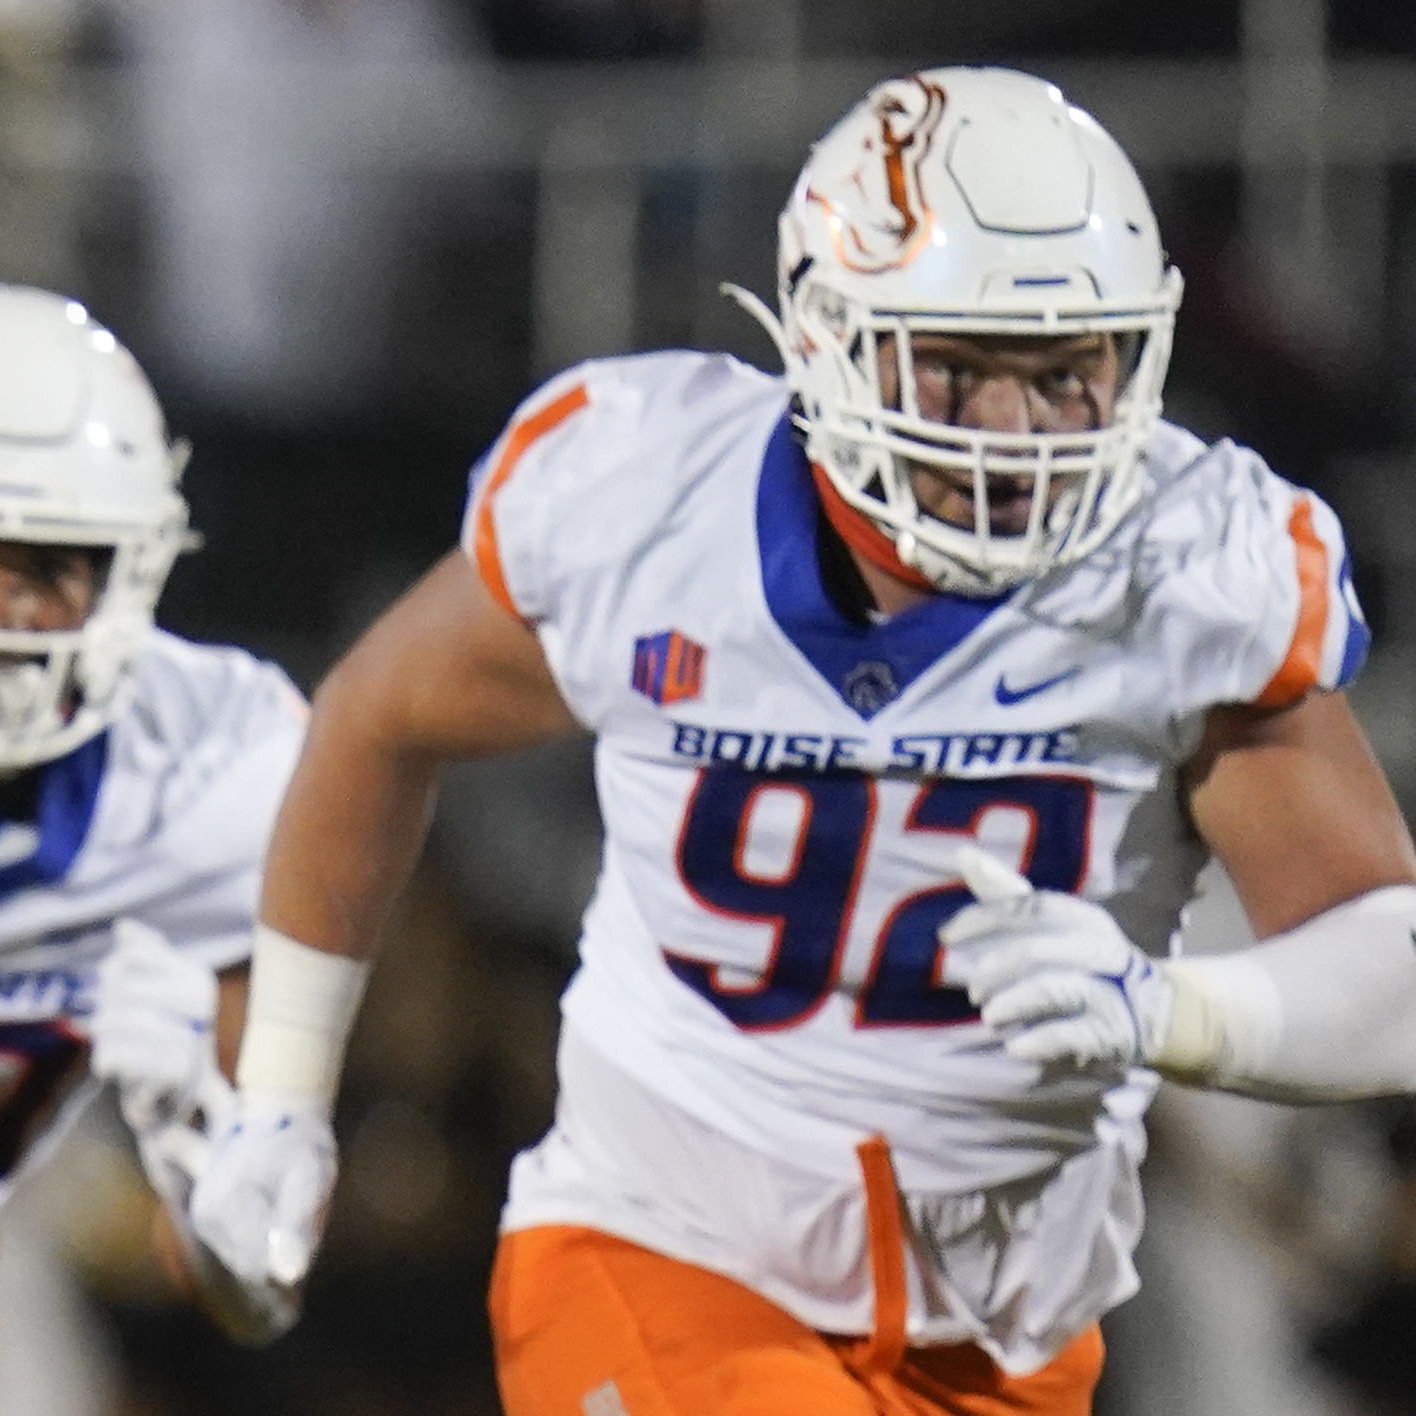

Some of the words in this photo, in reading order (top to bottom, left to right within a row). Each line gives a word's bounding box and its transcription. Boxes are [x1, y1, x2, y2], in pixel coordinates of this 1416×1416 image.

[672, 721, 866, 772] BOISE
[892, 727, 1080, 770] STATE
[659, 766, 1095, 1033] 92
